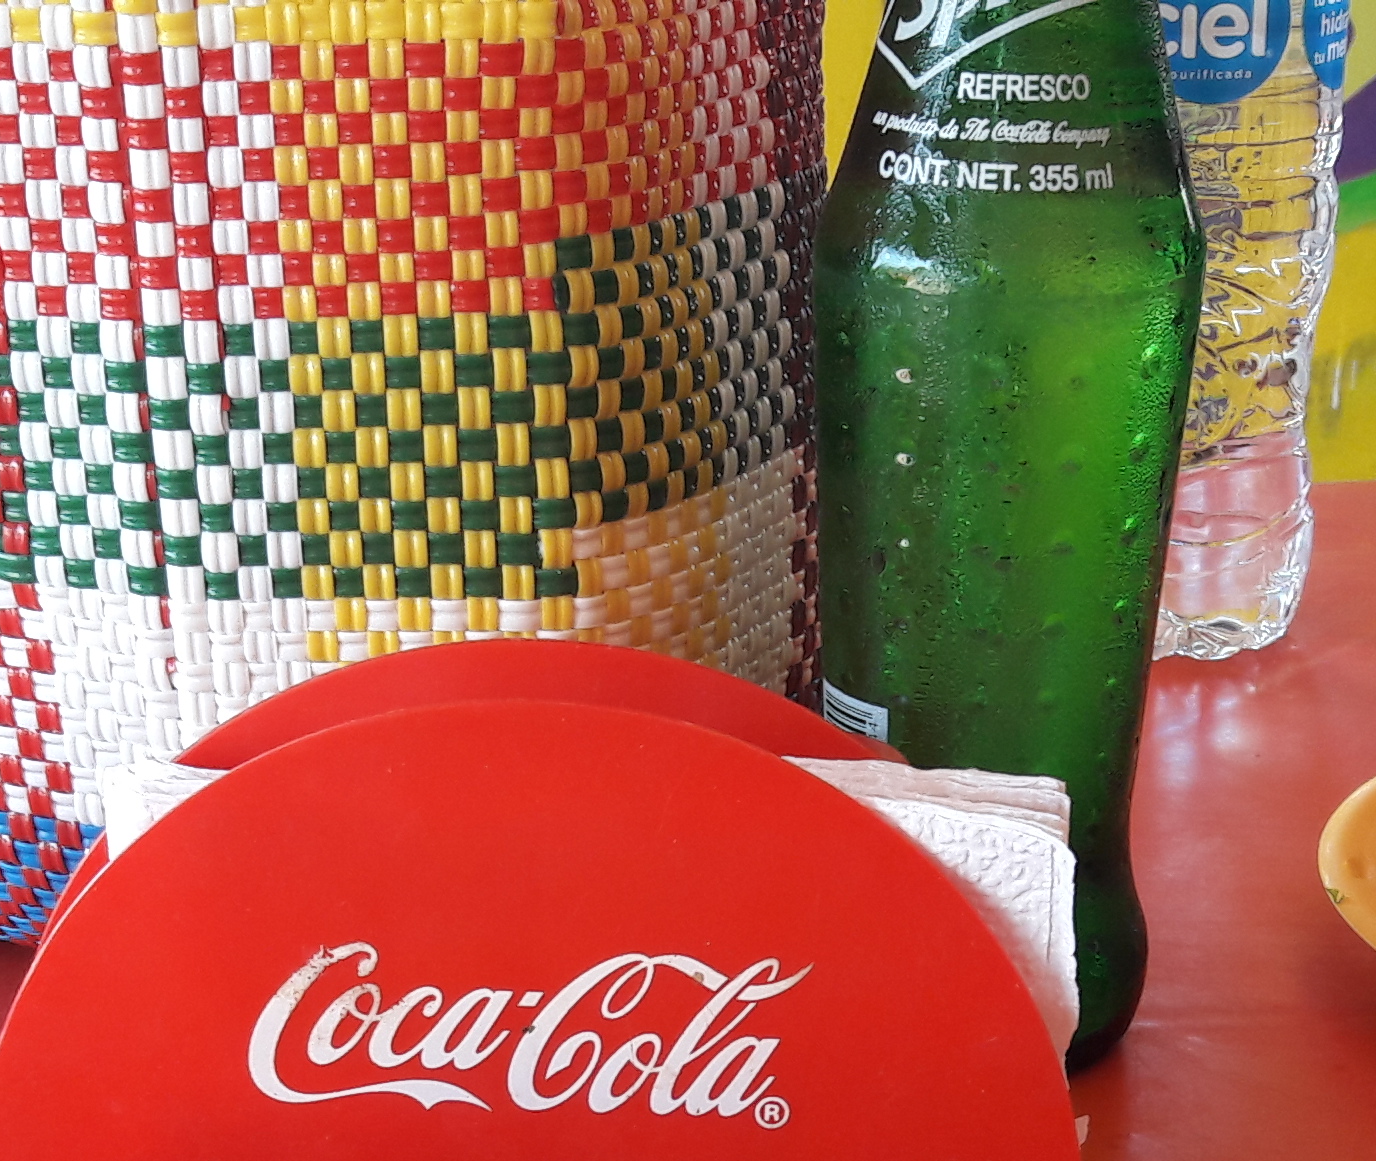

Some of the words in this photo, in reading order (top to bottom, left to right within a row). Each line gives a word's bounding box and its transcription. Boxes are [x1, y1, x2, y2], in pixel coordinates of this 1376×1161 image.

[957, 71, 1091, 102] REFRESCO
[960, 118, 990, 141] The
[1053, 120, 1111, 150] Company
[879, 150, 949, 188] CONT.
[957, 161, 1021, 191] NET.
[1028, 164, 1078, 192] 355
[1085, 162, 1114, 190] ml
[248, 940, 815, 1118] Coca-Cola
